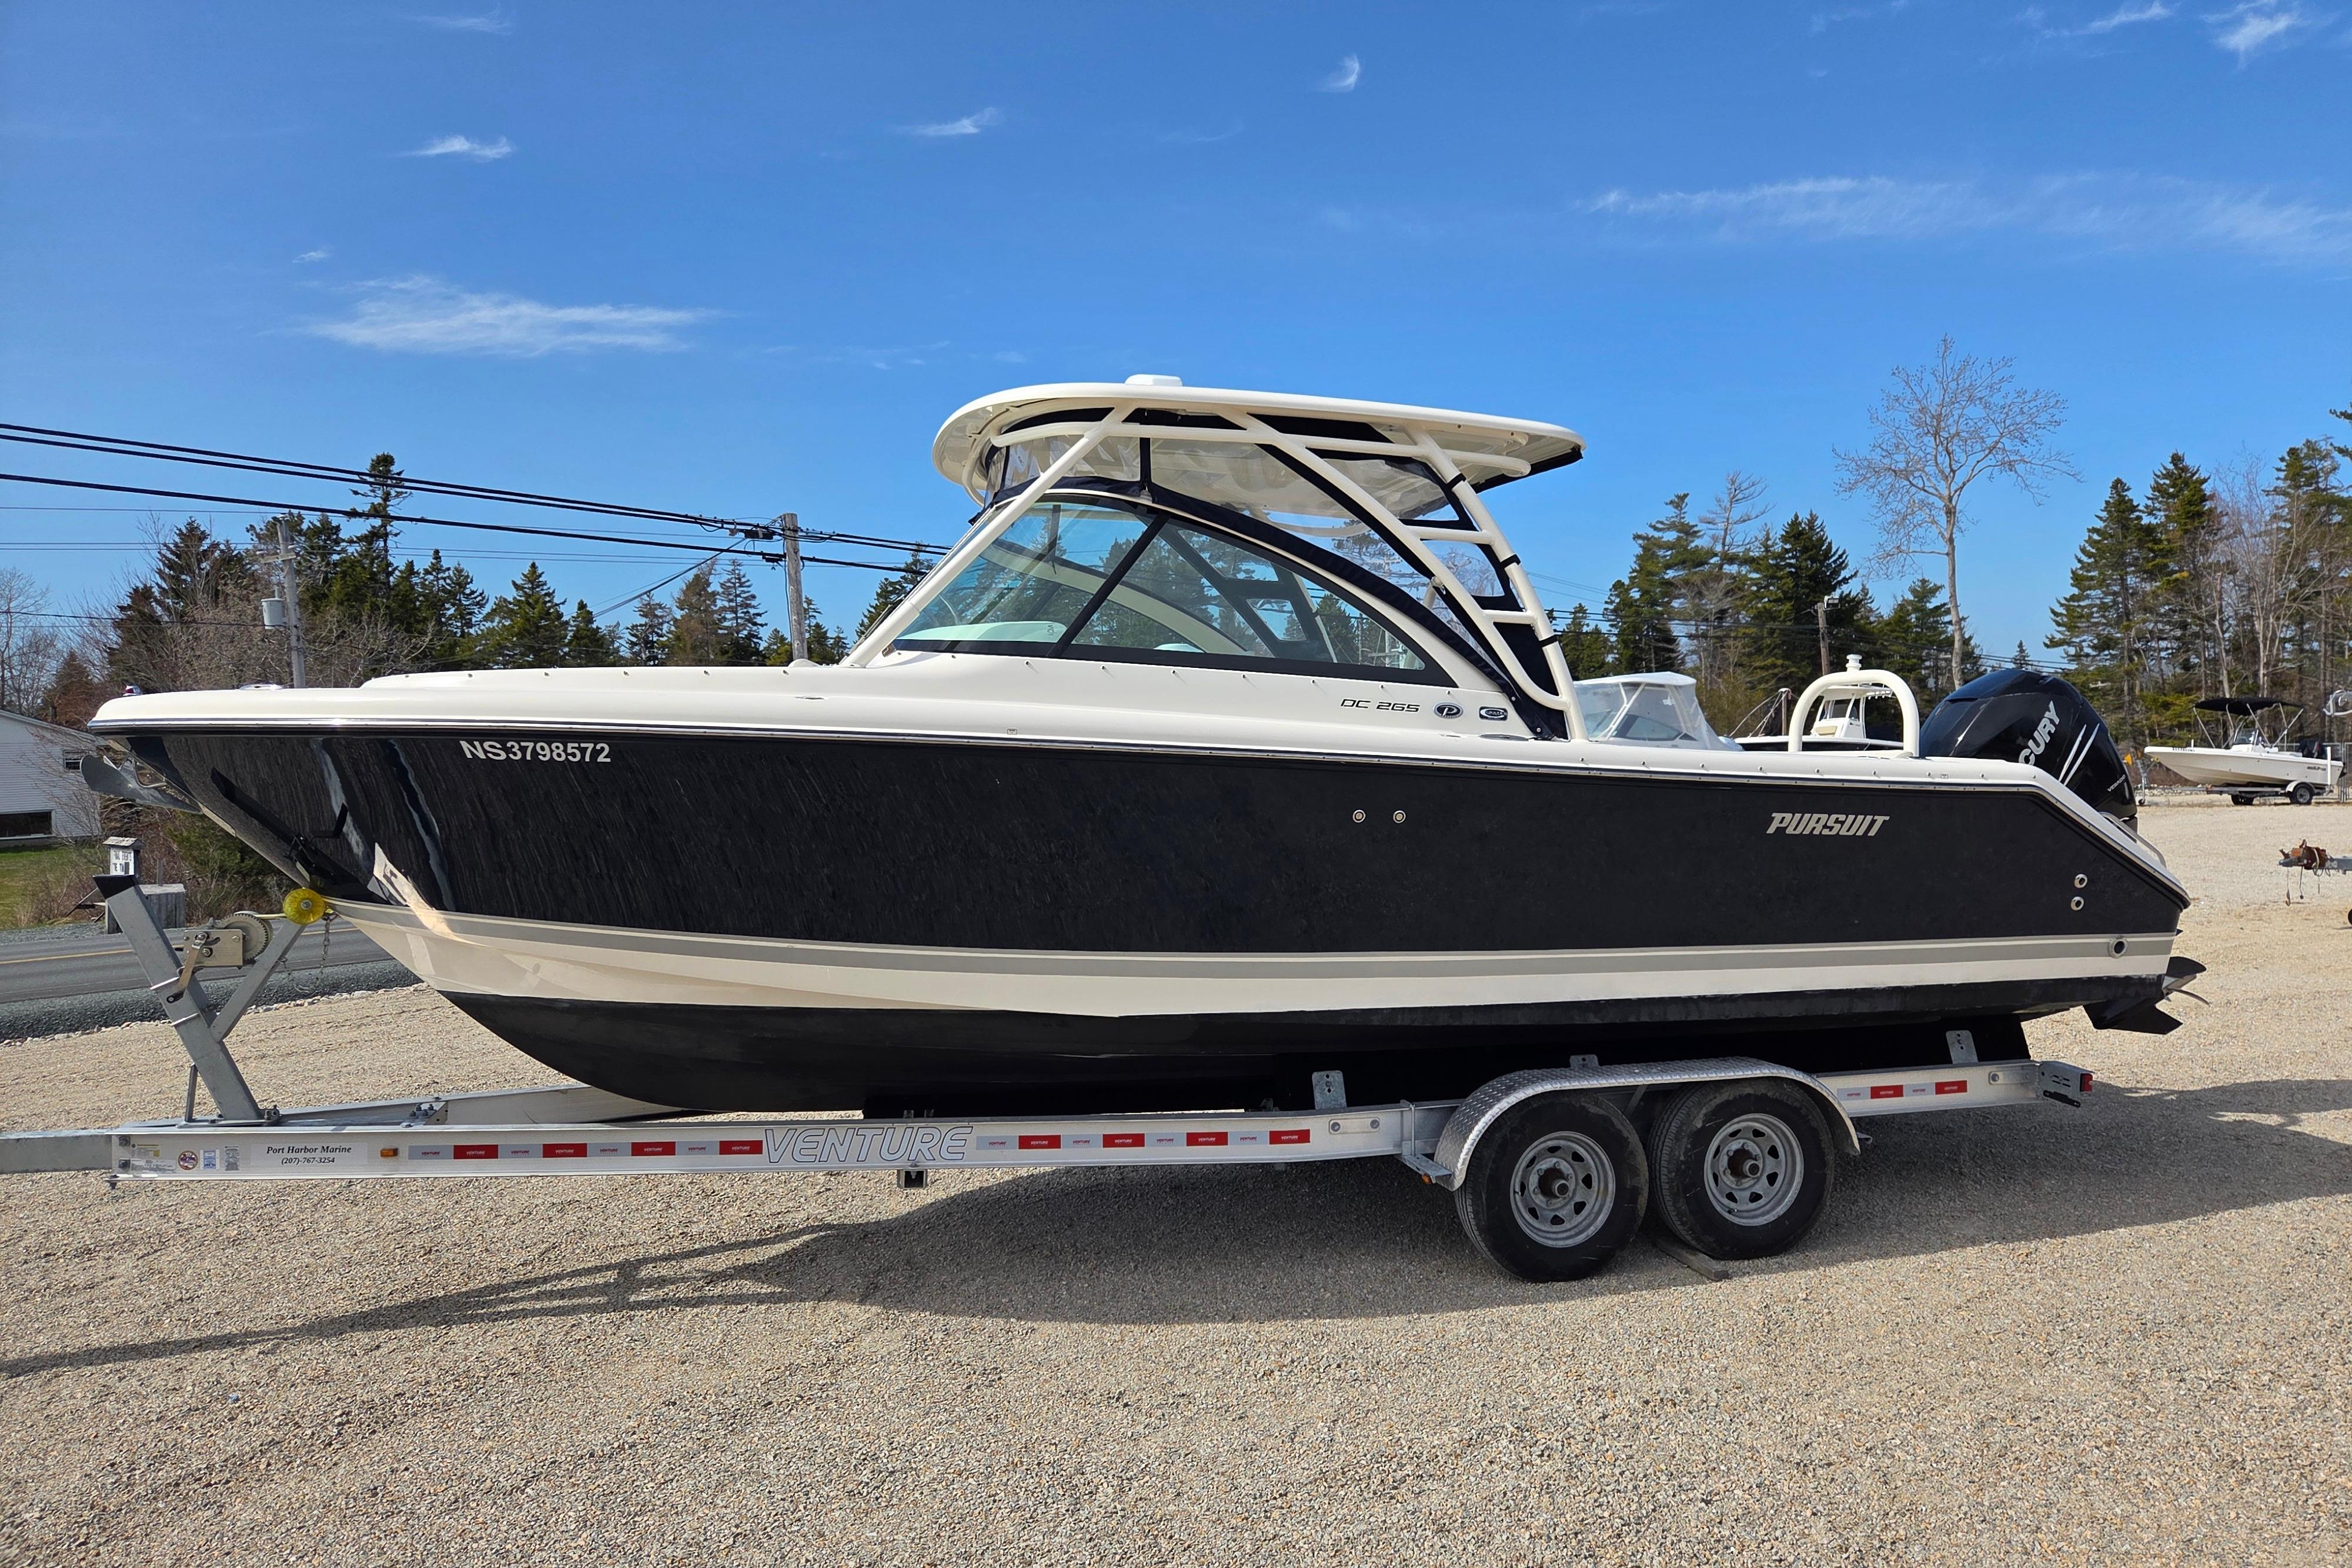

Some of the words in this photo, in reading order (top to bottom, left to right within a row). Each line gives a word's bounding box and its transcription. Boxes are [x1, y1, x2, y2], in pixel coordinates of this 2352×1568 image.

[1340, 698, 1371, 709] DC
[1376, 701, 1421, 713] 265
[2019, 700, 2060, 765] CURY
[459, 740, 611, 763] NS3798572
[1766, 813, 1890, 836] PURSUIT
[288, 1145, 318, 1154] Harbor
[320, 1145, 352, 1154] Marine
[764, 1125, 974, 1163] VENTURE
[281, 1156, 335, 1165] (207)-767-3254
